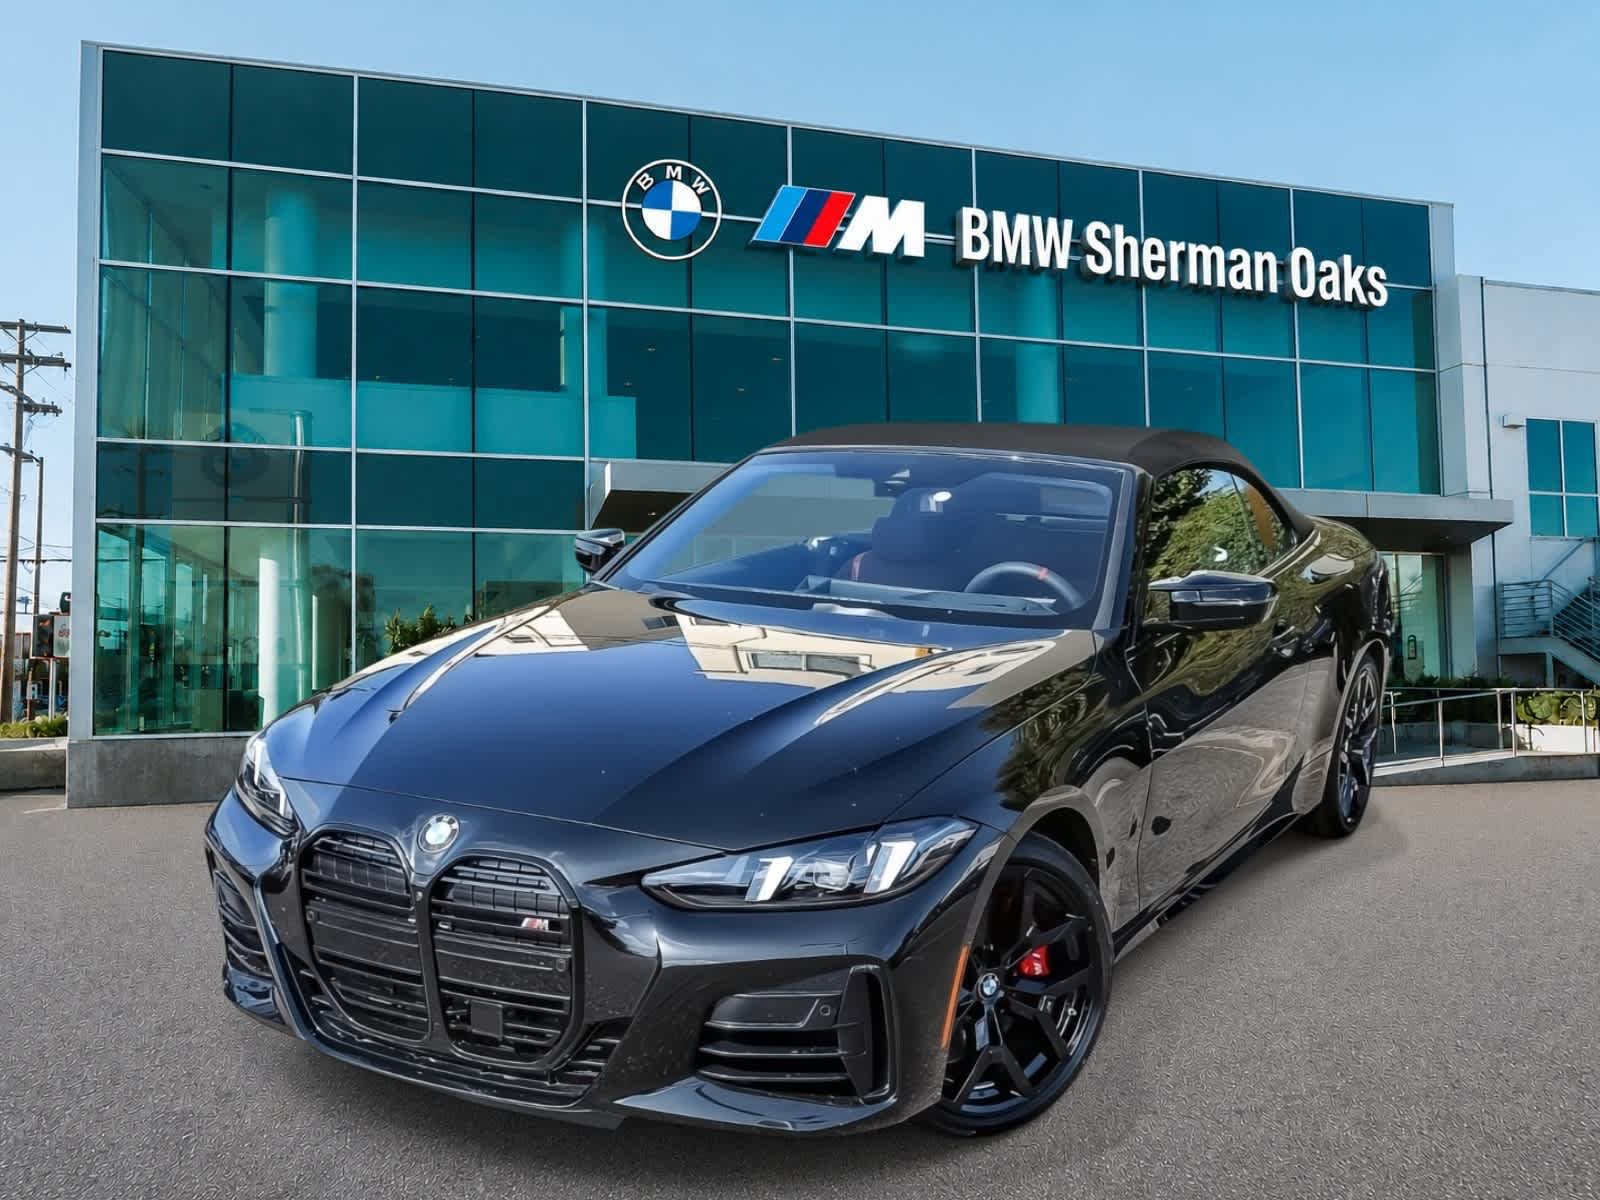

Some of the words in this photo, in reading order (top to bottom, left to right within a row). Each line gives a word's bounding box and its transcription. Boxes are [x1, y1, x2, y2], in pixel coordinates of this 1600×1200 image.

[636, 165, 710, 195] BMW
[836, 194, 925, 258] M
[960, 206, 1073, 270] BMW
[1084, 220, 1279, 293] Sherman
[1290, 246, 1389, 308] Oaks
